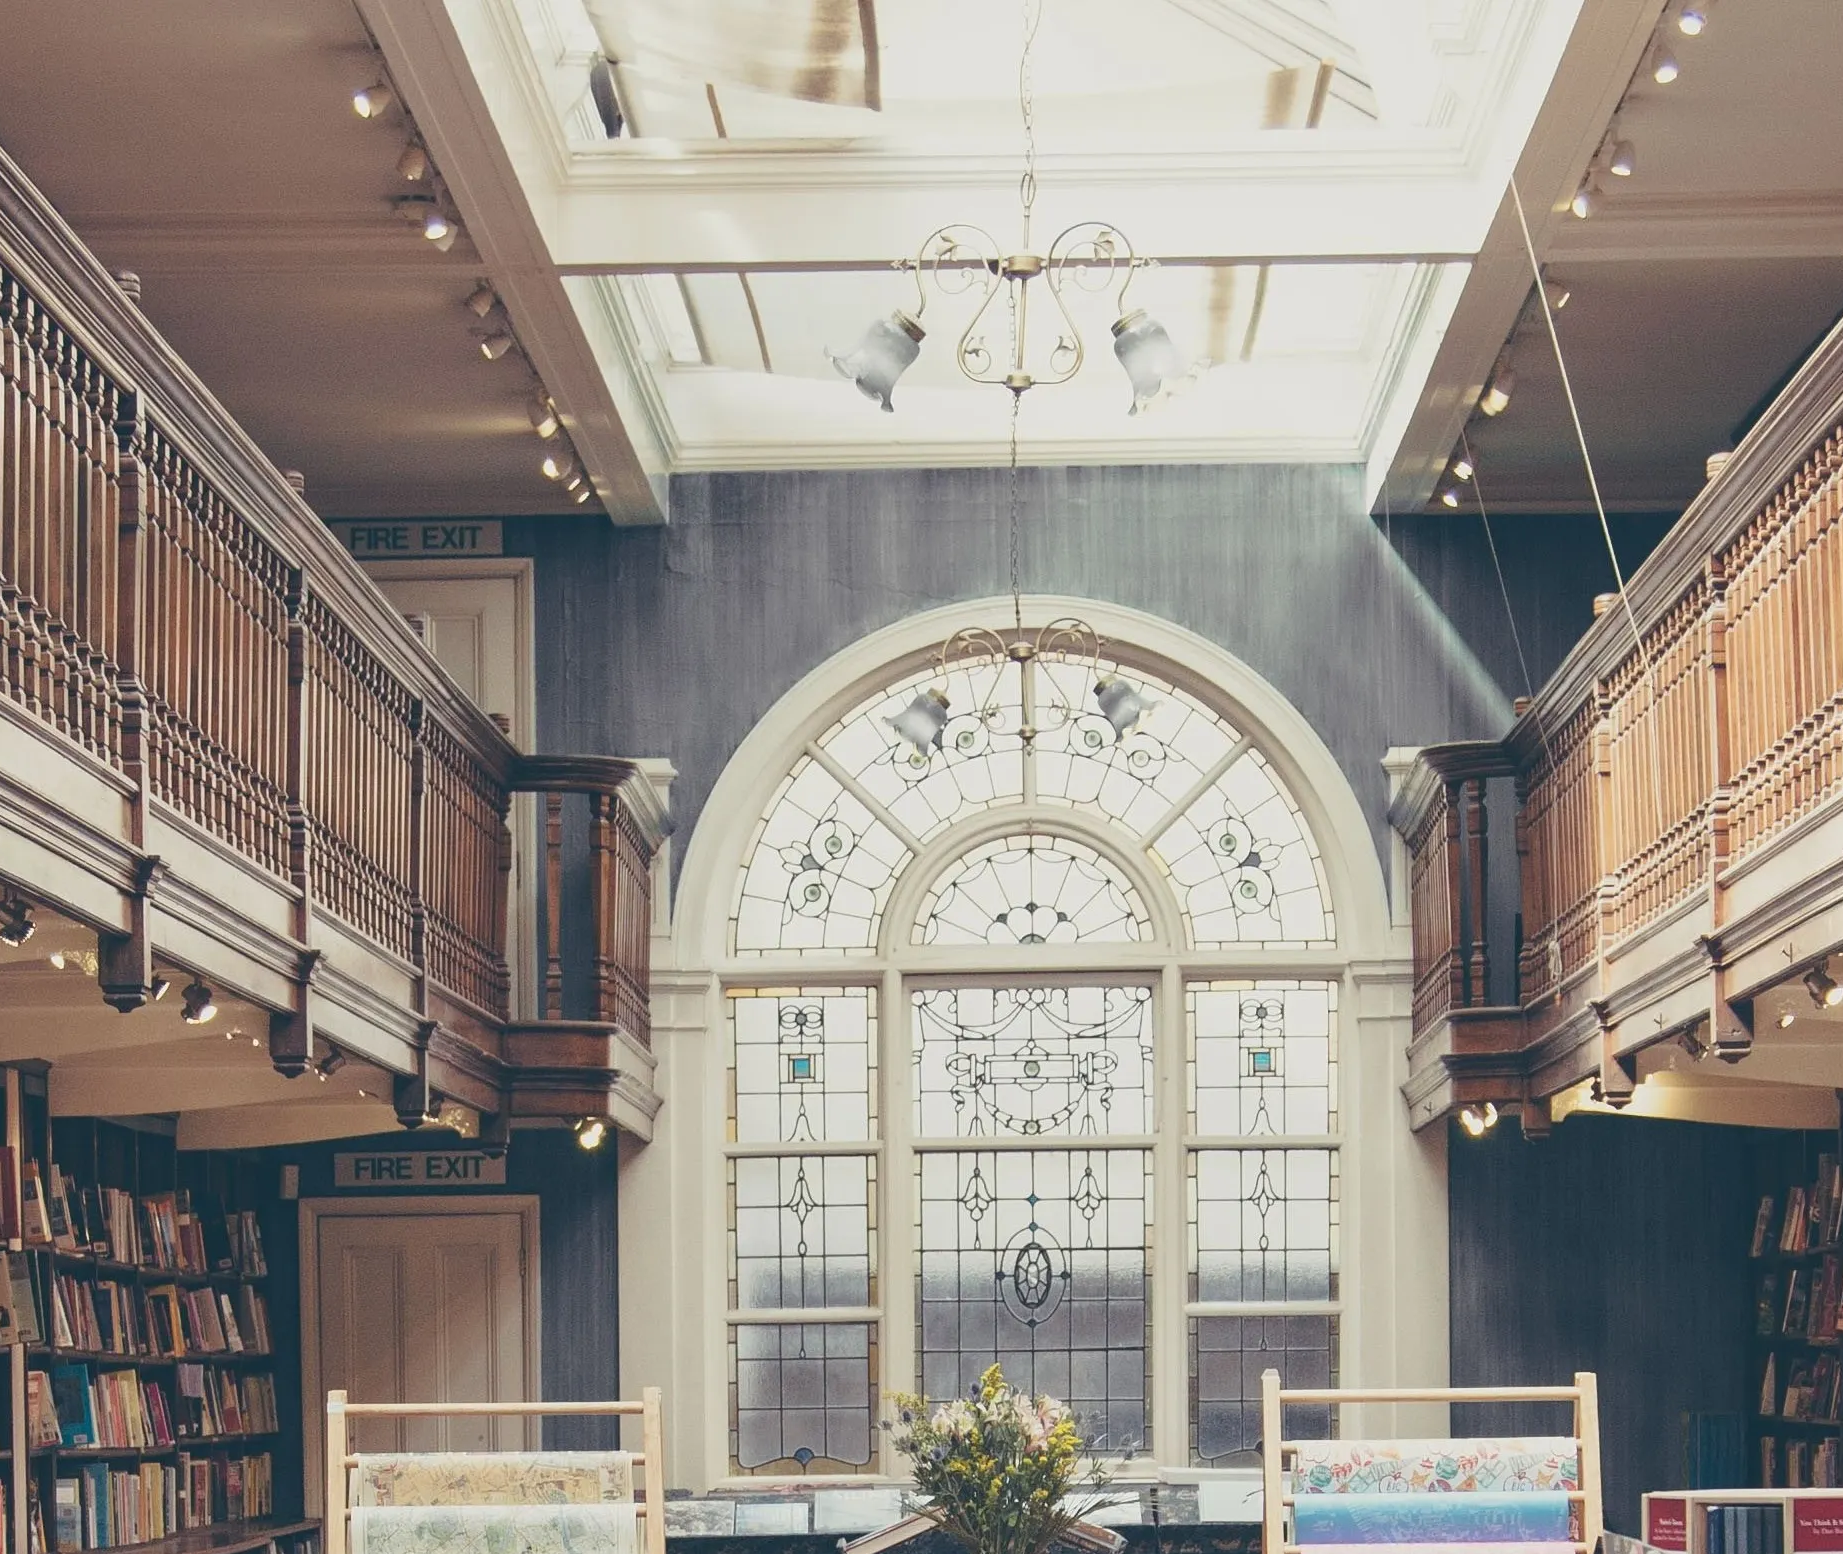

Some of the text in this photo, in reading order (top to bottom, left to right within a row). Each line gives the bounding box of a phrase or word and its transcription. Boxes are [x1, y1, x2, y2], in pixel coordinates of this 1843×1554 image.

[352, 525, 484, 551] FIRE EXIT
[354, 1156, 486, 1181] FIRE EXIT
[1799, 1519, 1812, 1527] You
[1813, 1519, 1831, 1527] Think
